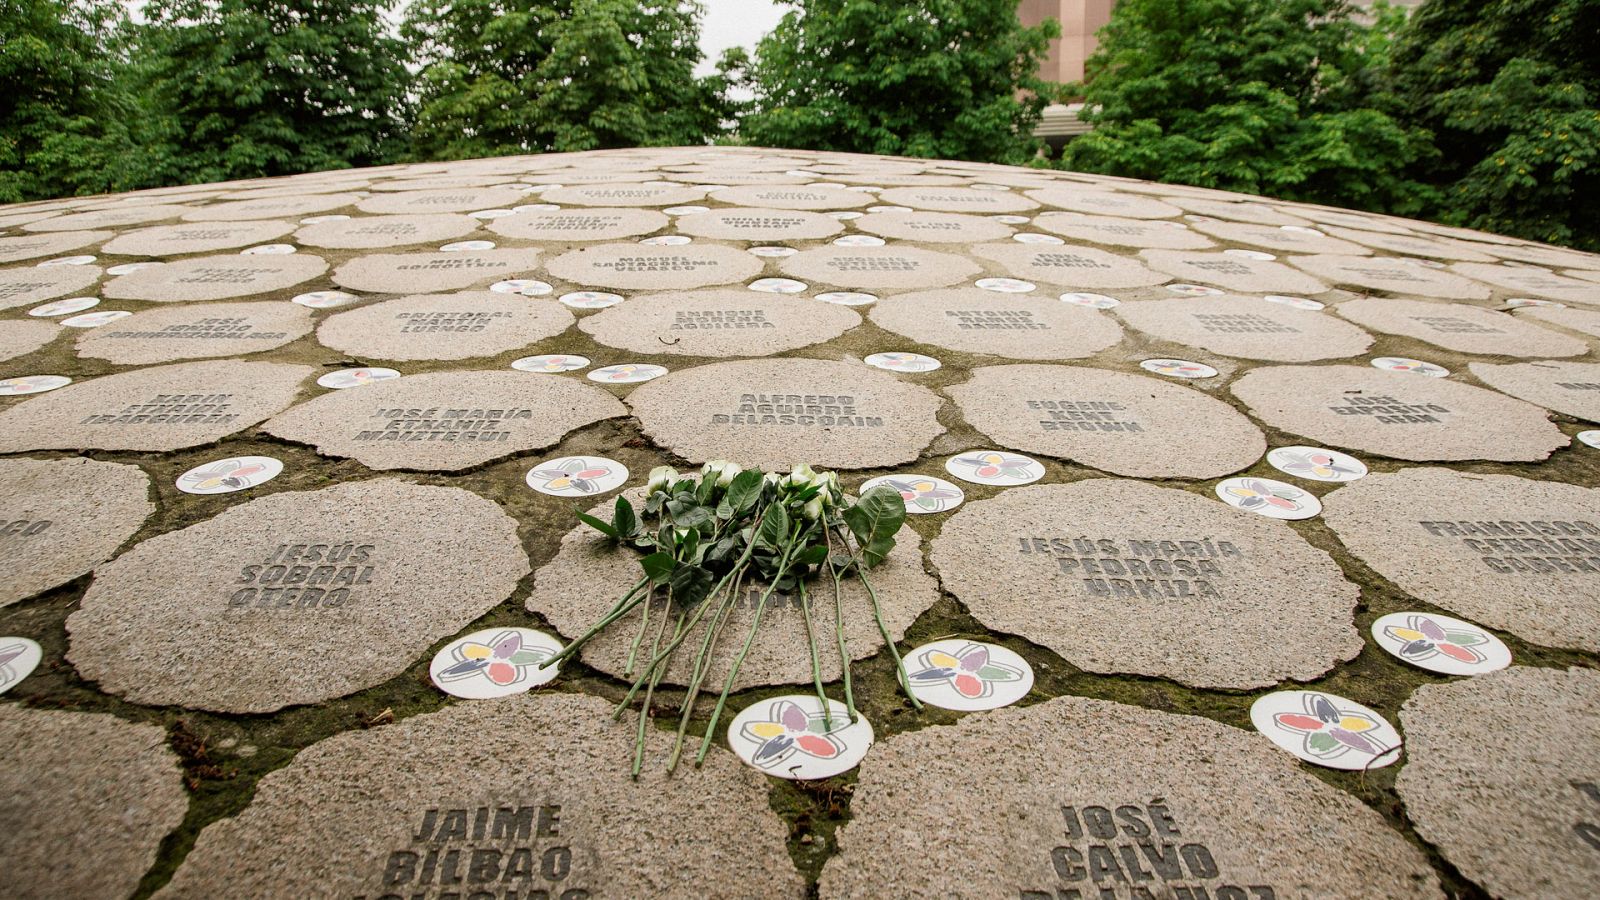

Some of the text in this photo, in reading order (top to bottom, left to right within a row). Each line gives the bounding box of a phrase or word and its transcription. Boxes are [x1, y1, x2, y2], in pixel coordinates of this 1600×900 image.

[400, 325, 485, 333] LUENGO
[737, 403, 857, 415] AGUIRRE
[739, 393, 855, 405] ALFREDO
[1026, 400, 1125, 411] EUGENE
[369, 406, 532, 419] JOSÉ MARÍA
[1048, 410, 1115, 421] KENT
[351, 430, 511, 442] MAIZTEGUI
[1039, 420, 1145, 432] BROWN
[263, 541, 376, 565] JESÚS
[1019, 535, 1245, 559] JESÚS MARÍA
[236, 564, 376, 586] SOBRAL
[1057, 557, 1224, 578] PEDROSA
[228, 587, 352, 609] OTERO
[1082, 578, 1224, 600] URKIZA
[411, 804, 563, 844] JAIME
[1060, 797, 1182, 841] JOSÉ
[381, 845, 573, 886] BILBAO
[1050, 842, 1220, 882] CALVO
